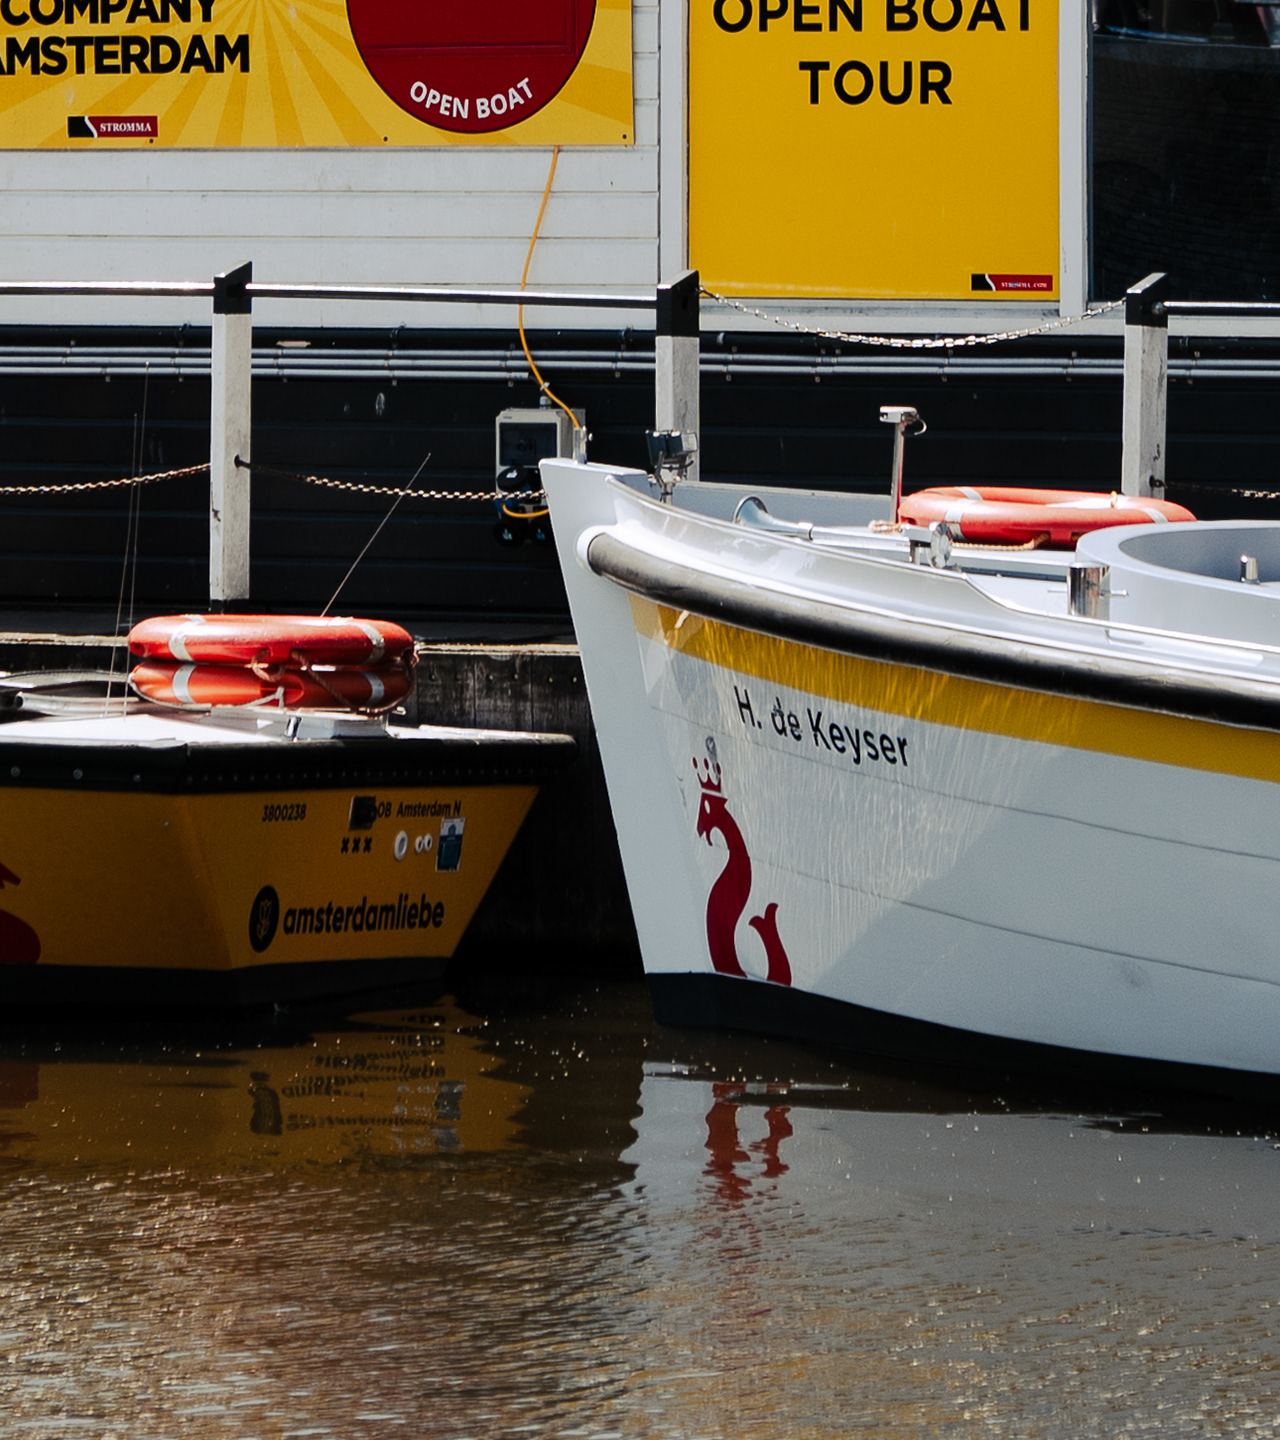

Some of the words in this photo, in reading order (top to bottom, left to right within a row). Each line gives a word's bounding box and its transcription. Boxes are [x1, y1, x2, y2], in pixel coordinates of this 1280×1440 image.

[409, 81, 469, 120] OPEN
[475, 77, 533, 120] BOAT
[798, 60, 953, 106] TOUR
[99, 122, 152, 132] STROMMA
[733, 685, 763, 730] H.
[770, 696, 803, 742] de
[806, 708, 908, 767] Keyser
[261, 803, 308, 822] 3800238
[396, 800, 451, 818] Amsterdam
[452, 800, 462, 816] N
[282, 892, 446, 936] amsterdamliebe
